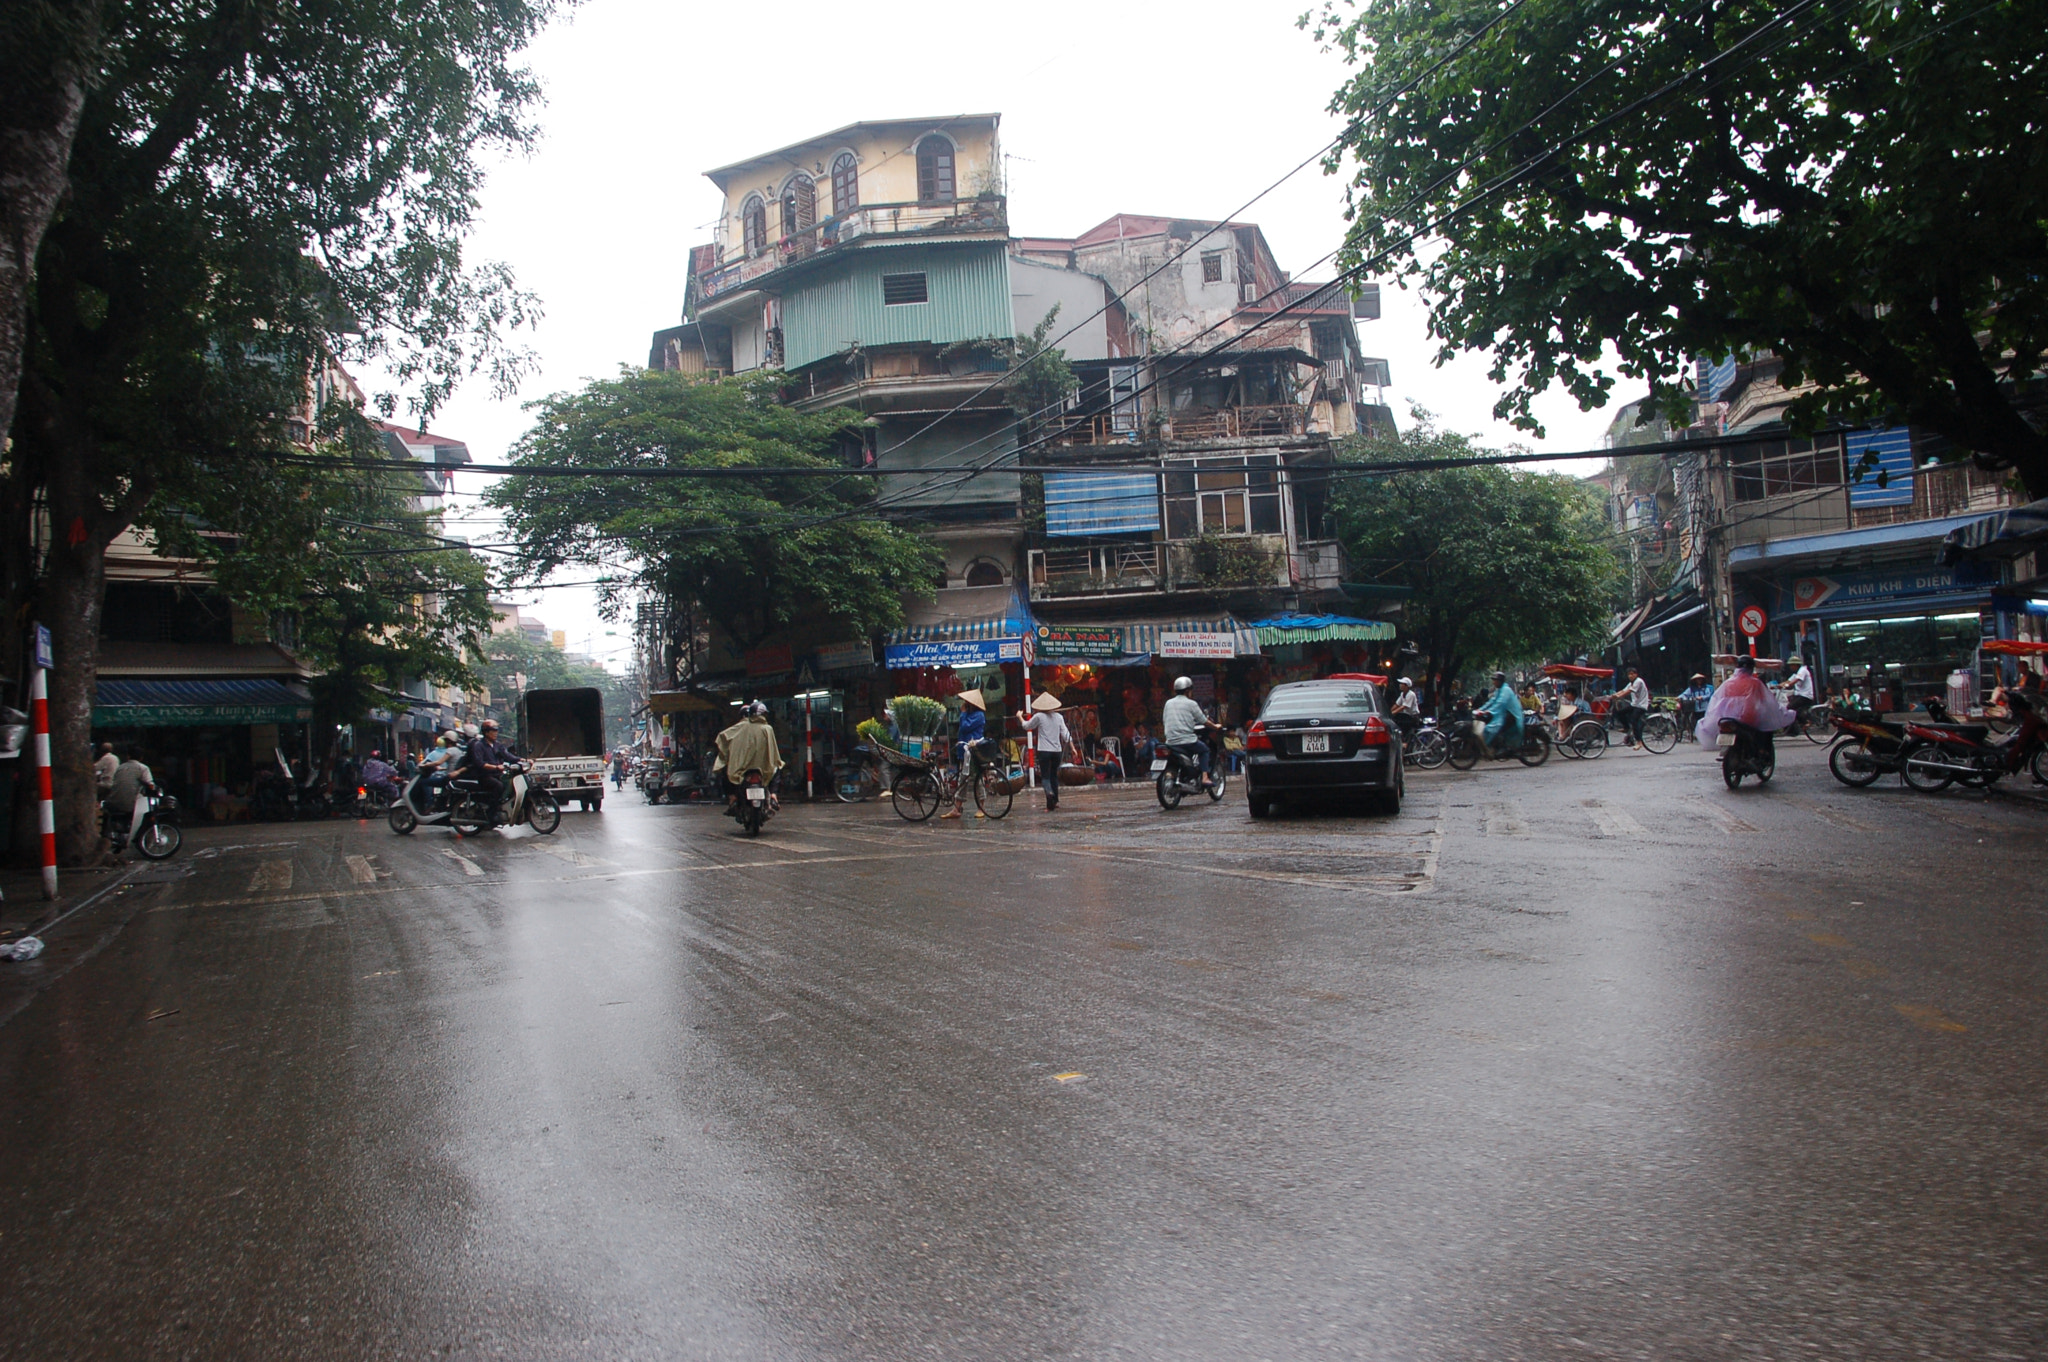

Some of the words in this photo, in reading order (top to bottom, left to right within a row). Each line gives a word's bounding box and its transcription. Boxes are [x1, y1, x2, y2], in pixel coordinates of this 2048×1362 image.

[1848, 583, 1874, 596] KIM
[1075, 633, 1110, 641] NAM
[160, 706, 204, 716] HÀNG
[1306, 743, 1325, 751] 4148
[548, 763, 586, 771] SUZUKI
